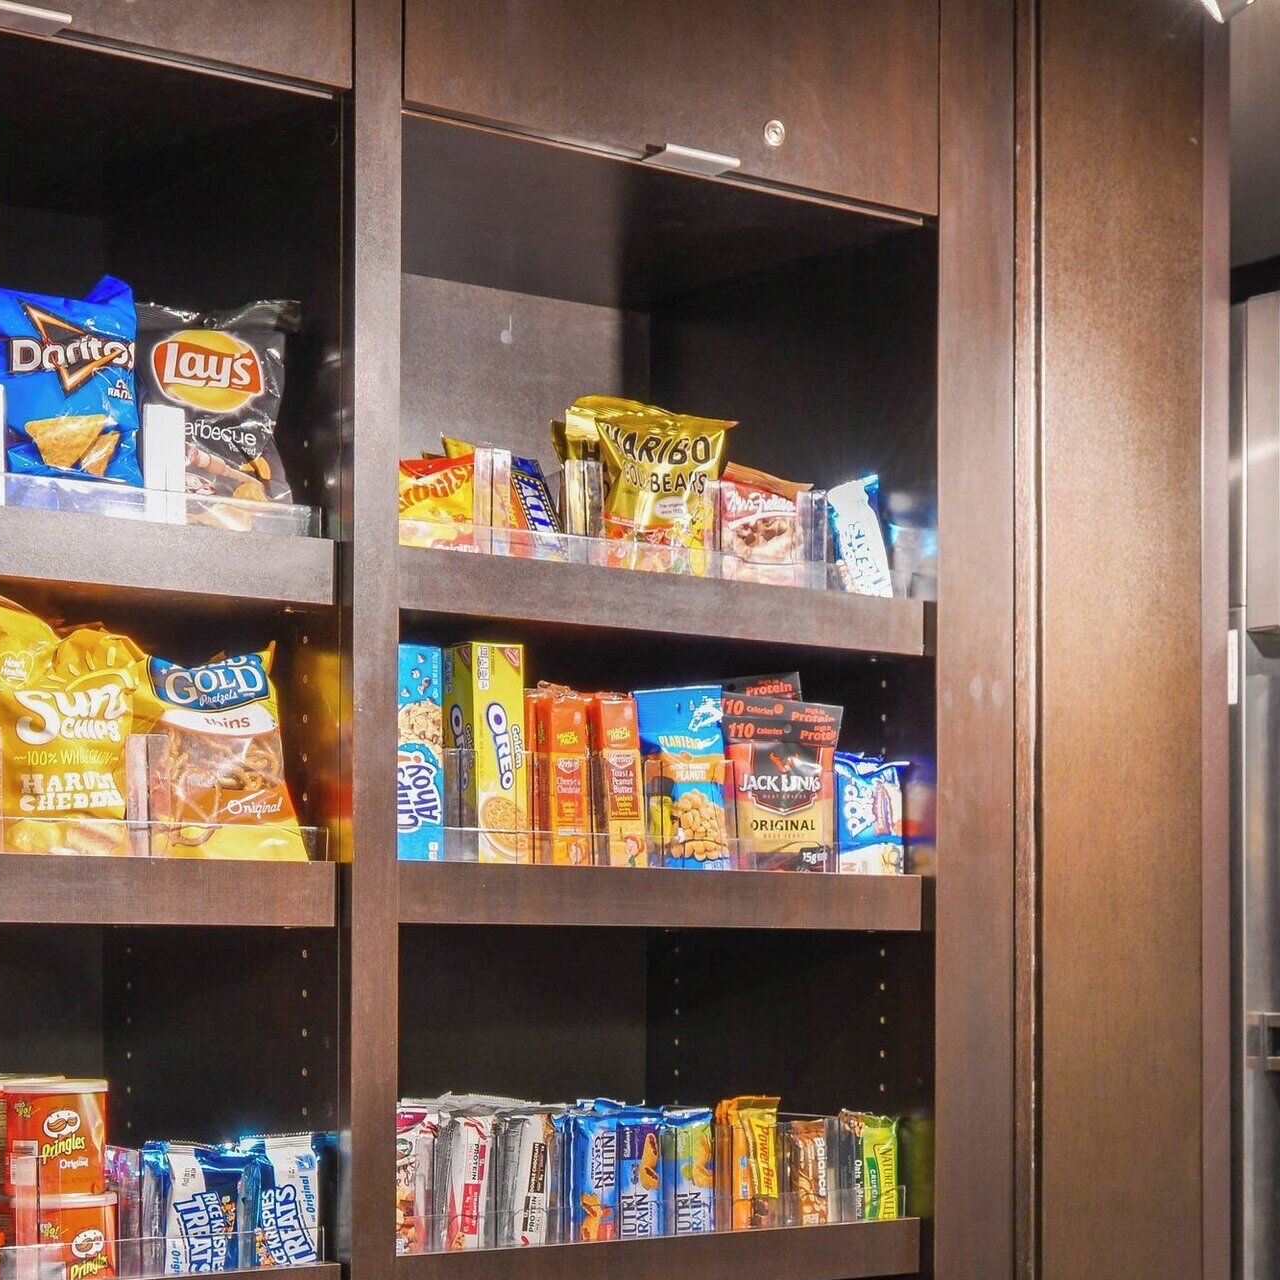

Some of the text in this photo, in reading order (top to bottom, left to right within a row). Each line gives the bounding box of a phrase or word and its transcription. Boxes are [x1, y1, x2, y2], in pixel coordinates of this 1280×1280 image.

[163, 342, 254, 389] Lay's
[184, 418, 258, 447] arbecue
[165, 664, 264, 705] GOLD
[199, 690, 239, 707] Pretzels
[745, 681, 793, 697] Protein
[13, 684, 128, 746] Sun
[728, 722, 783, 739] 110 Calories
[26, 750, 58, 767] 100%
[485, 702, 515, 791] OREO
[739, 773, 779, 793] JACK
[750, 819, 817, 832] ORIGINAL
[41, 1133, 86, 1166] Pringles
[470, 1143, 480, 1182] PROTEIN
[594, 1136, 604, 1190] GRAIN
[602, 1134, 616, 1189] NUTRI
[755, 1123, 776, 1193] PowerBar
[813, 1137, 827, 1197] Balance
[878, 1145, 895, 1187] NATURE
[853, 1158, 863, 1180] Oats
[202, 1192, 222, 1219] RICE
[299, 1175, 316, 1214] Original
[528, 1195, 538, 1233] PROTEIN
